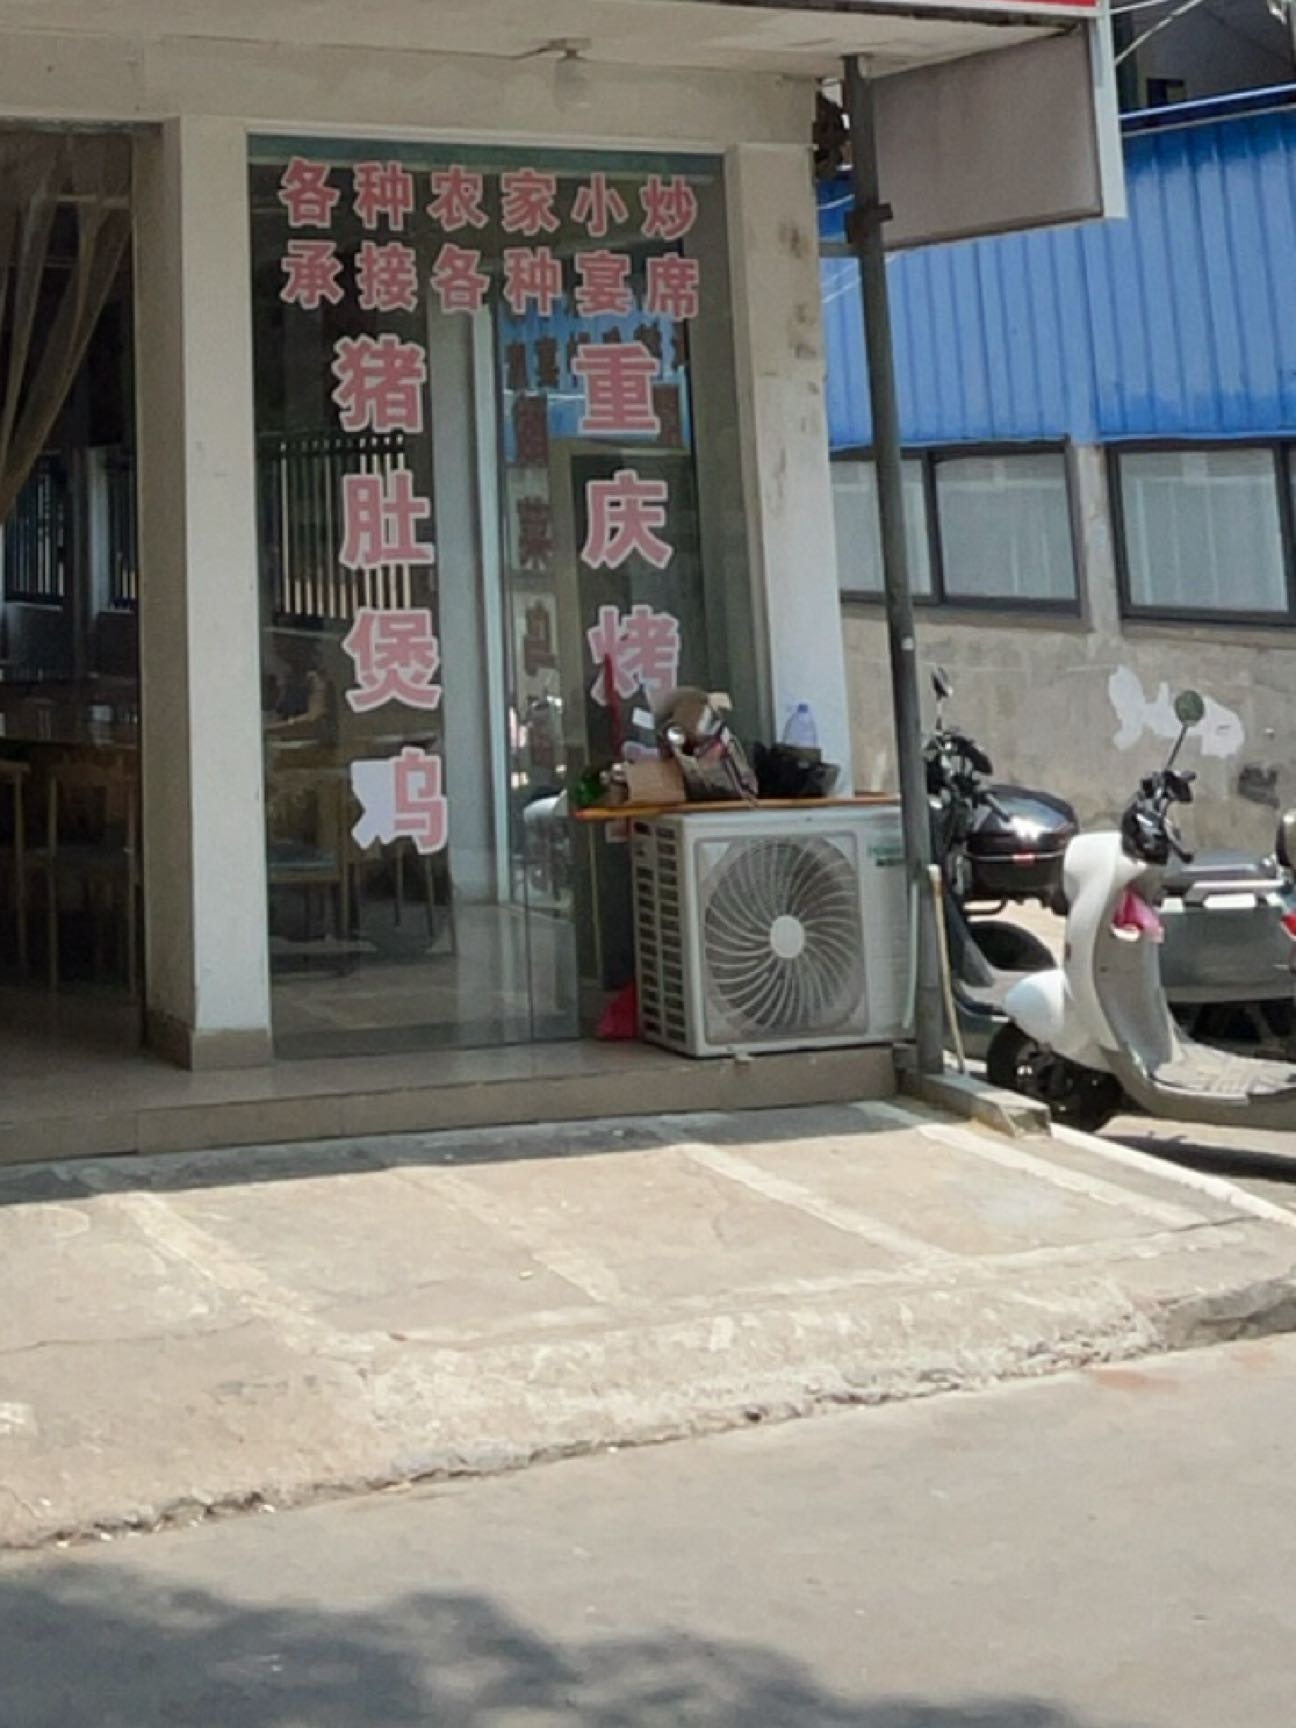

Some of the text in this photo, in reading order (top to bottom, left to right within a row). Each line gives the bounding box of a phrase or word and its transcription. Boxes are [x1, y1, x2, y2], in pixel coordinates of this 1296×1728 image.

[278, 156, 699, 241] 各种农家小炒
[281, 239, 700, 320] 承接各种宴席
[571, 342, 682, 762] 重庆烤
